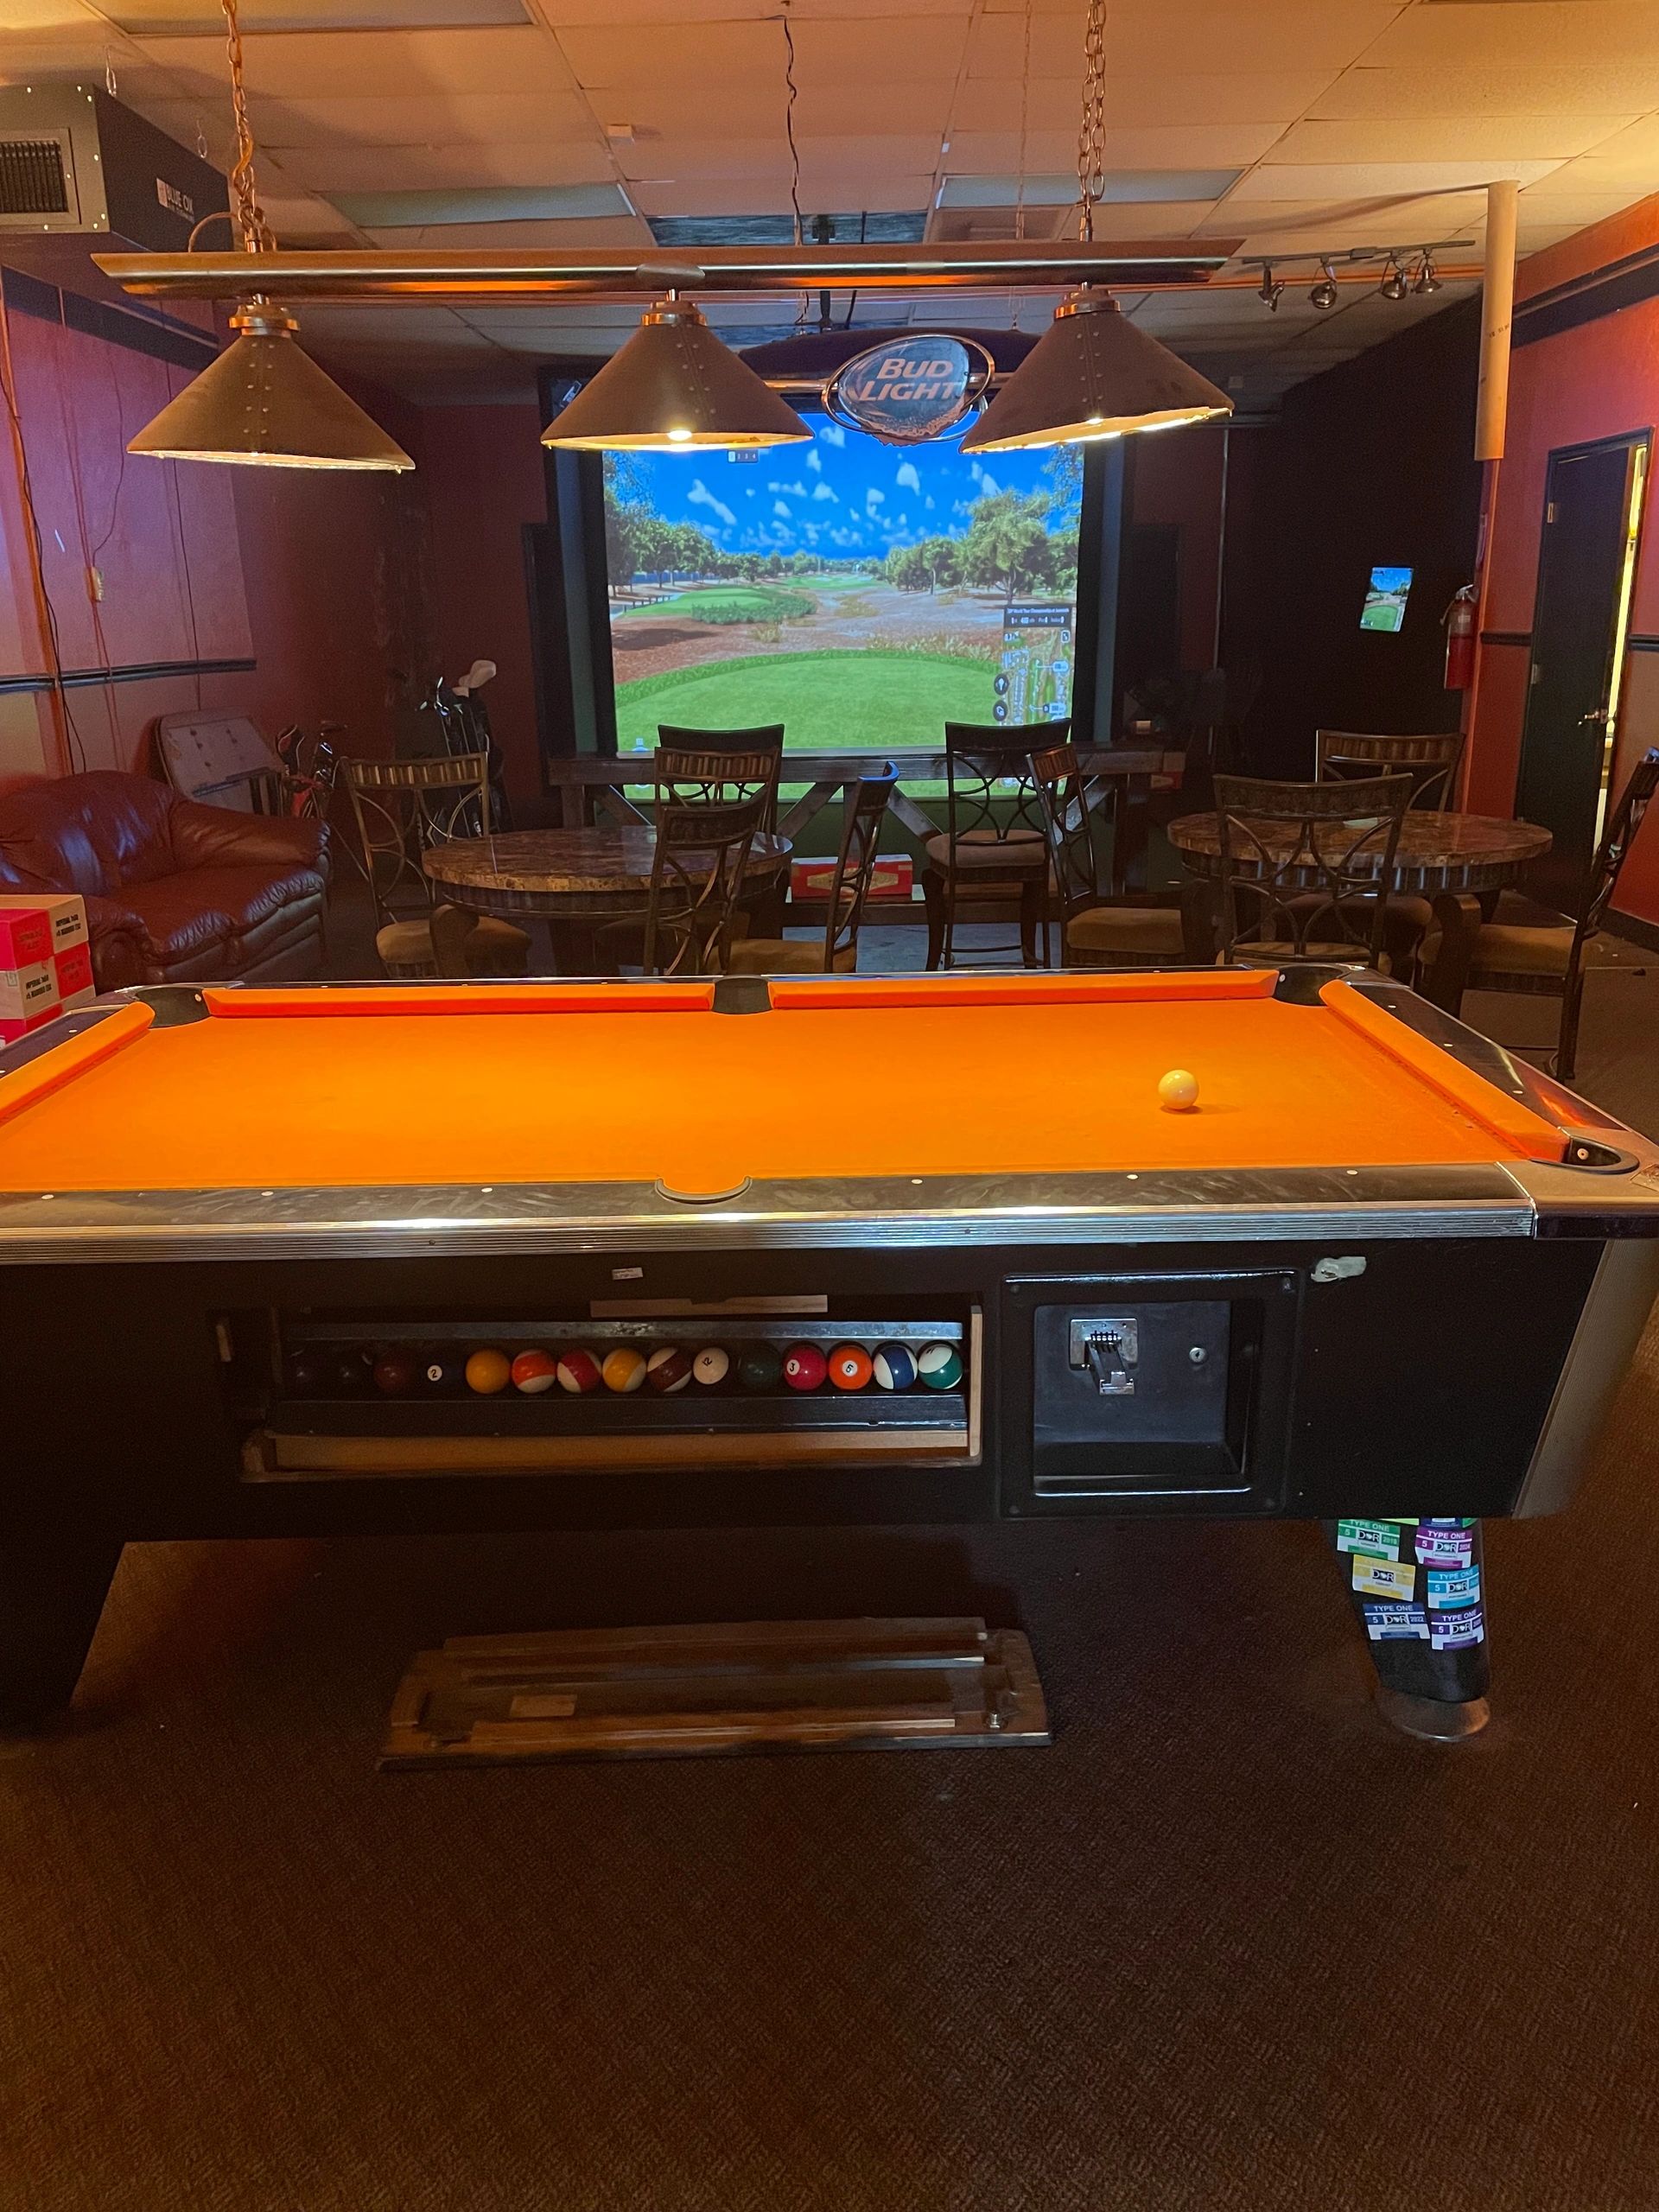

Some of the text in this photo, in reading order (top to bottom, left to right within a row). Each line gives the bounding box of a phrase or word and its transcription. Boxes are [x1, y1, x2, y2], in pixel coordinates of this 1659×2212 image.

[876, 358, 954, 379] BUD
[858, 380, 963, 401] LIGHT
[702, 1357, 712, 1366] 12
[790, 1363, 795, 1372] 3
[431, 1369, 438, 1378] 2
[1351, 1520, 1390, 1532] TYPE ONE
[1427, 1530, 1449, 1539] TYPE
[1460, 1568, 1473, 1578] ONE
[1463, 1609, 1477, 1618] ONE
